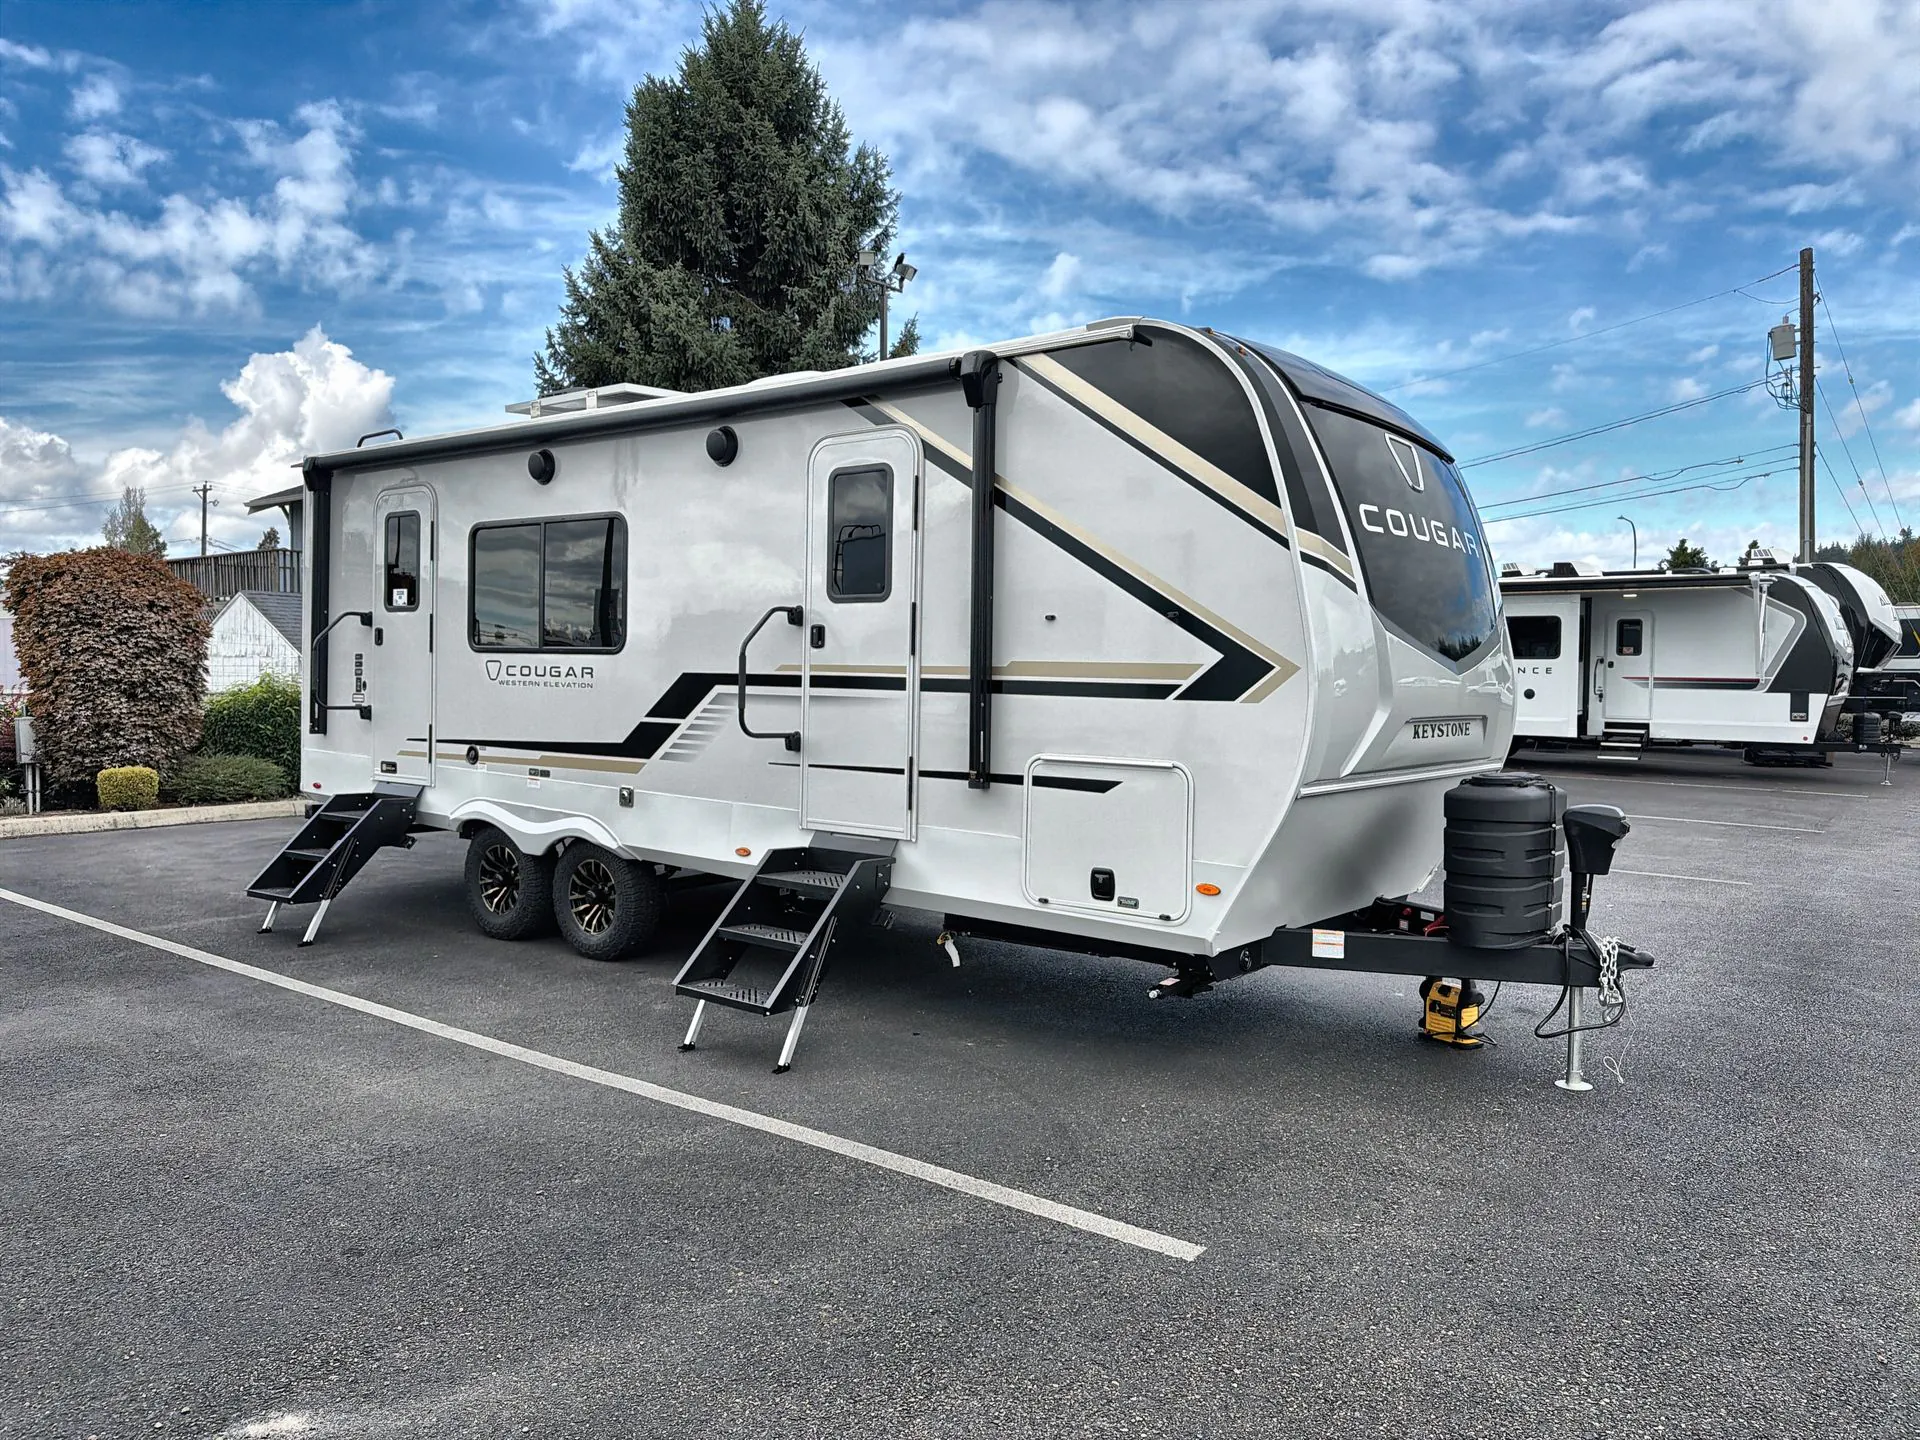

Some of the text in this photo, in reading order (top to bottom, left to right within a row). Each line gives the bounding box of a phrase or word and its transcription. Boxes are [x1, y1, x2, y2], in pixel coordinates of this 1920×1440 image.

[1359, 504, 1479, 558] COUGAR
[506, 665, 594, 678] COUGAR
[543, 681, 594, 689] ELEVATION
[1412, 722, 1471, 740] KEYSTONE
